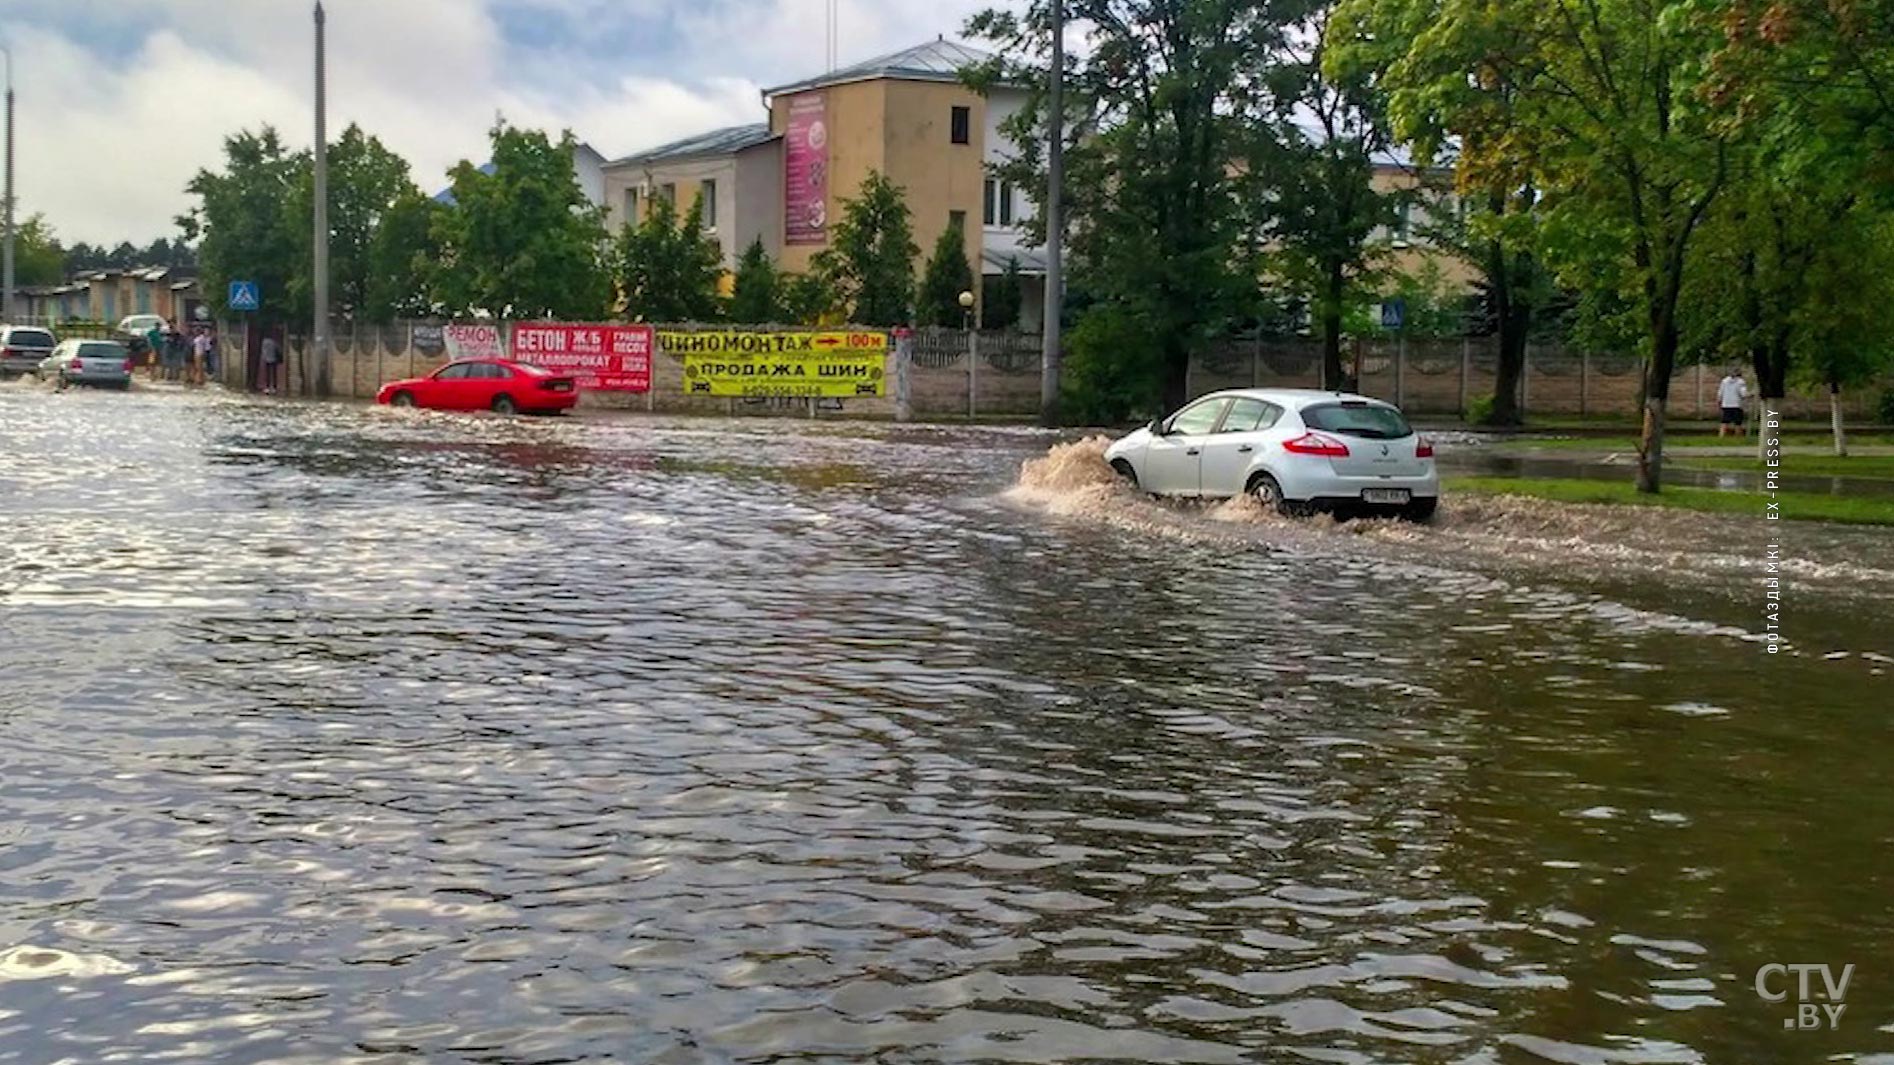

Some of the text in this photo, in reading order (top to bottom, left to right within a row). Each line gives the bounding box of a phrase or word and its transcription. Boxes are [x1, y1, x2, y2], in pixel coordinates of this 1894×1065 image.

[517, 329, 567, 351] БЕТОН
[613, 343, 648, 353] ПЕСОК
[701, 363, 867, 376] ПРОДАЖА ШИН
